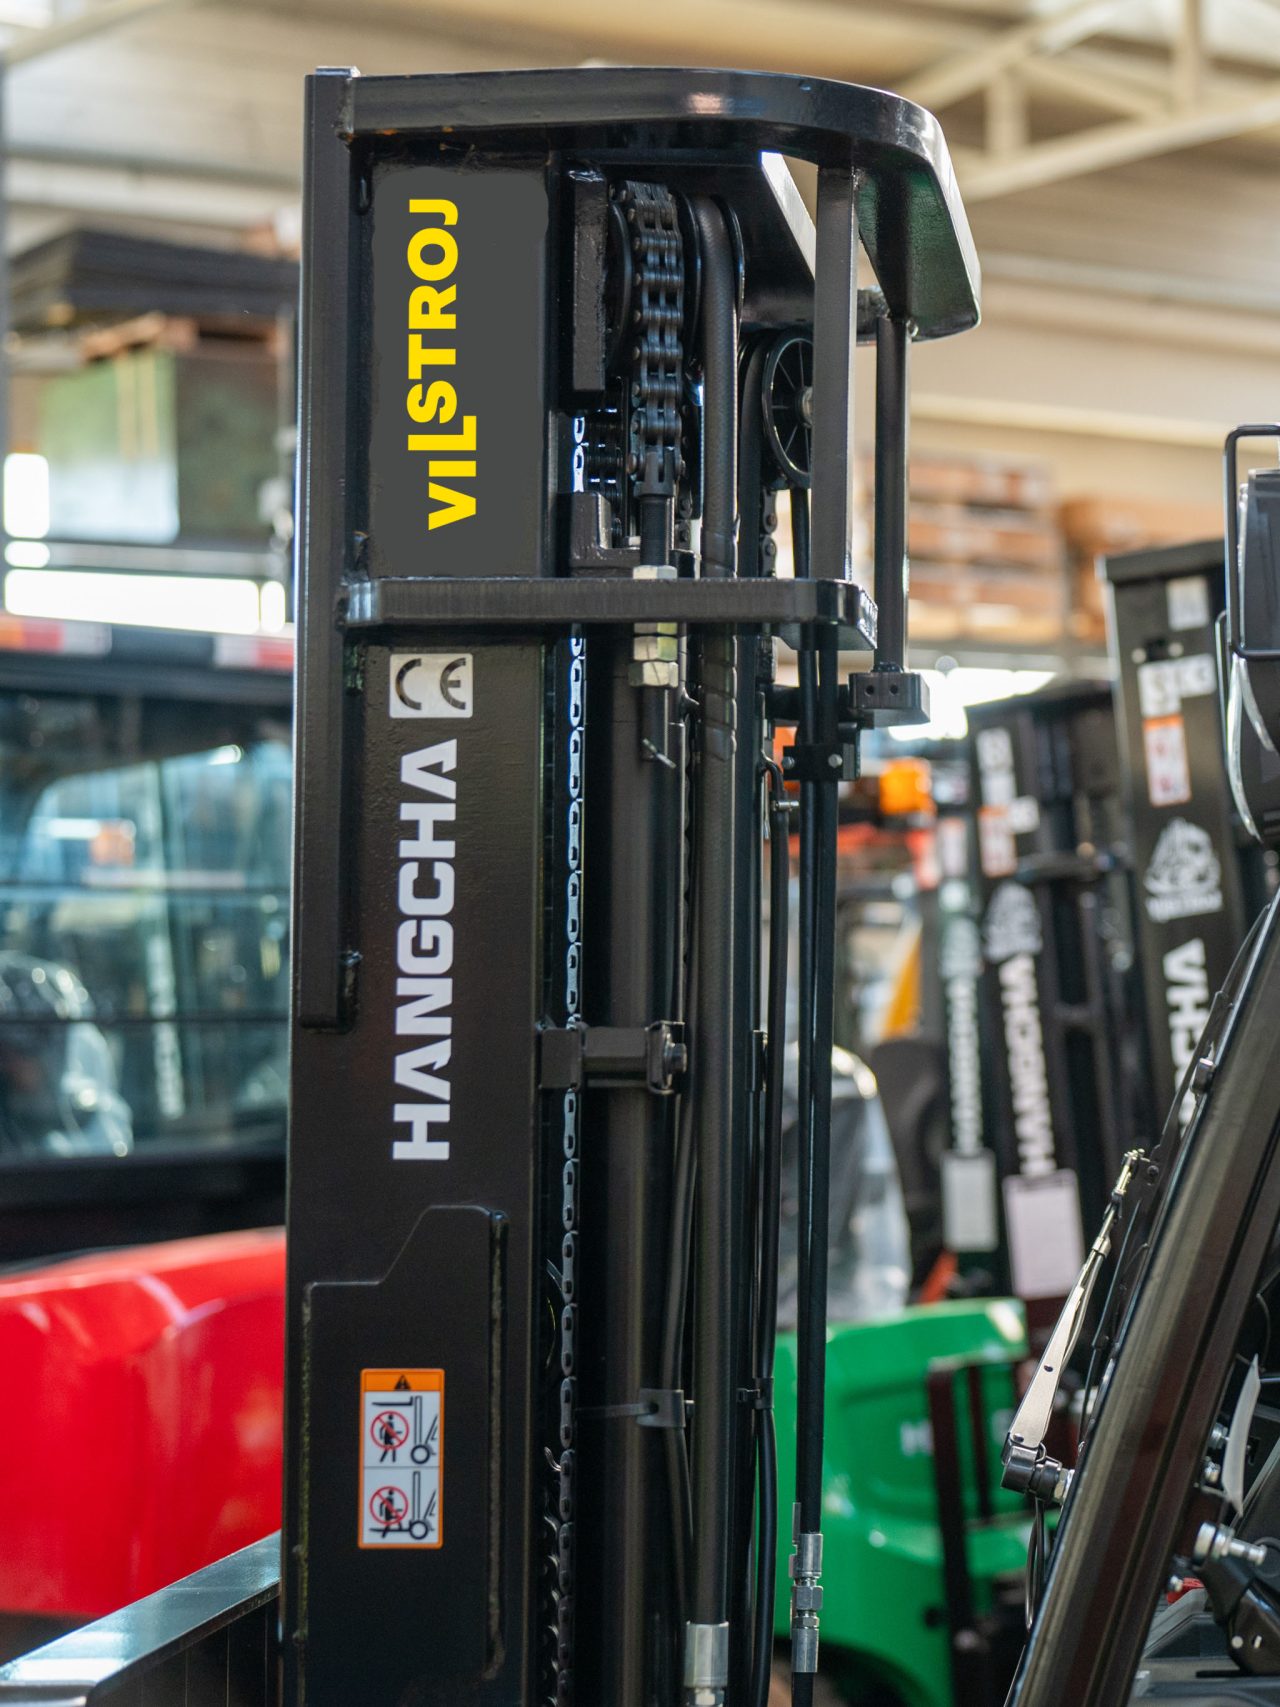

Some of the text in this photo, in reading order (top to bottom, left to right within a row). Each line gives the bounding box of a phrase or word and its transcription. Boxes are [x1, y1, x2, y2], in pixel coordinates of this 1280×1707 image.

[406, 198, 478, 531] VILSTROJ
[395, 657, 466, 711] CE
[393, 738, 457, 1161] HANGCHA
